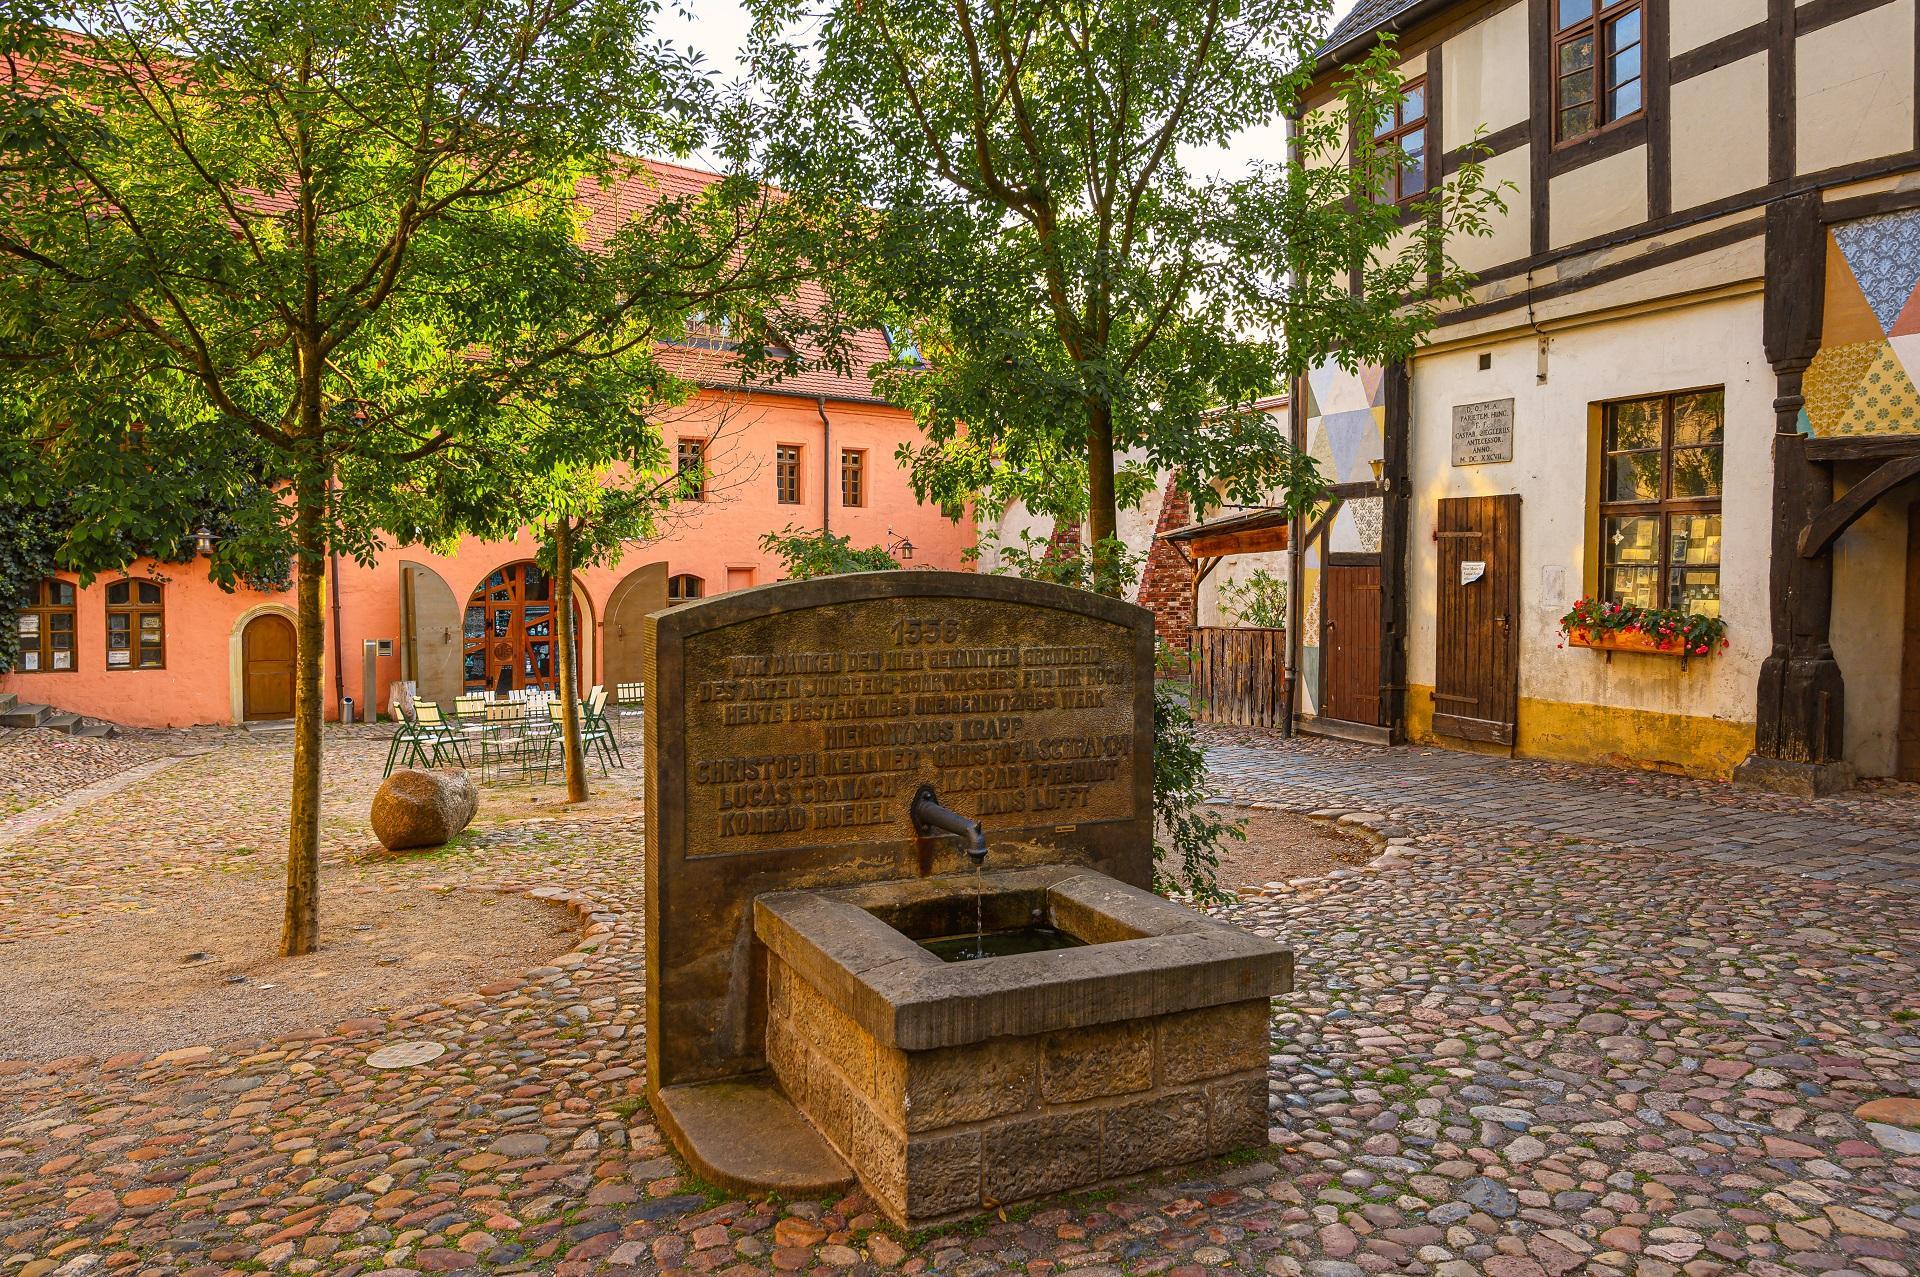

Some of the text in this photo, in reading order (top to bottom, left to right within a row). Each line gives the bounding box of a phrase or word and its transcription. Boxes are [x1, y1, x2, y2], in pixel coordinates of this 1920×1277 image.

[1455, 431, 1475, 439] CASPAR
[891, 617, 958, 646] 1556
[729, 655, 769, 676] WIR
[771, 651, 840, 674] DANKEN
[845, 651, 880, 672] DEN
[883, 650, 923, 670] HIER
[928, 648, 1018, 668] GENANNTEN
[698, 681, 738, 702] DES
[740, 679, 800, 700] ALTEN
[1057, 667, 1082, 686] IHR
[1084, 665, 1124, 685] NOCH
[723, 703, 782, 725] HEUTE
[787, 697, 909, 721] BESTEHENDES
[1059, 687, 1104, 709] WERK
[823, 716, 1023, 750] HIERONYMUS KRAPP
[696, 747, 920, 784] CHRISTOPH KELLNER
[933, 739, 1036, 768] CHRISTOPH
[719, 774, 897, 810] LUCAS CRANACH
[943, 766, 1020, 793] KASPAR
[976, 785, 1089, 816] HANS LUFFT
[719, 806, 807, 838] KONRAD
